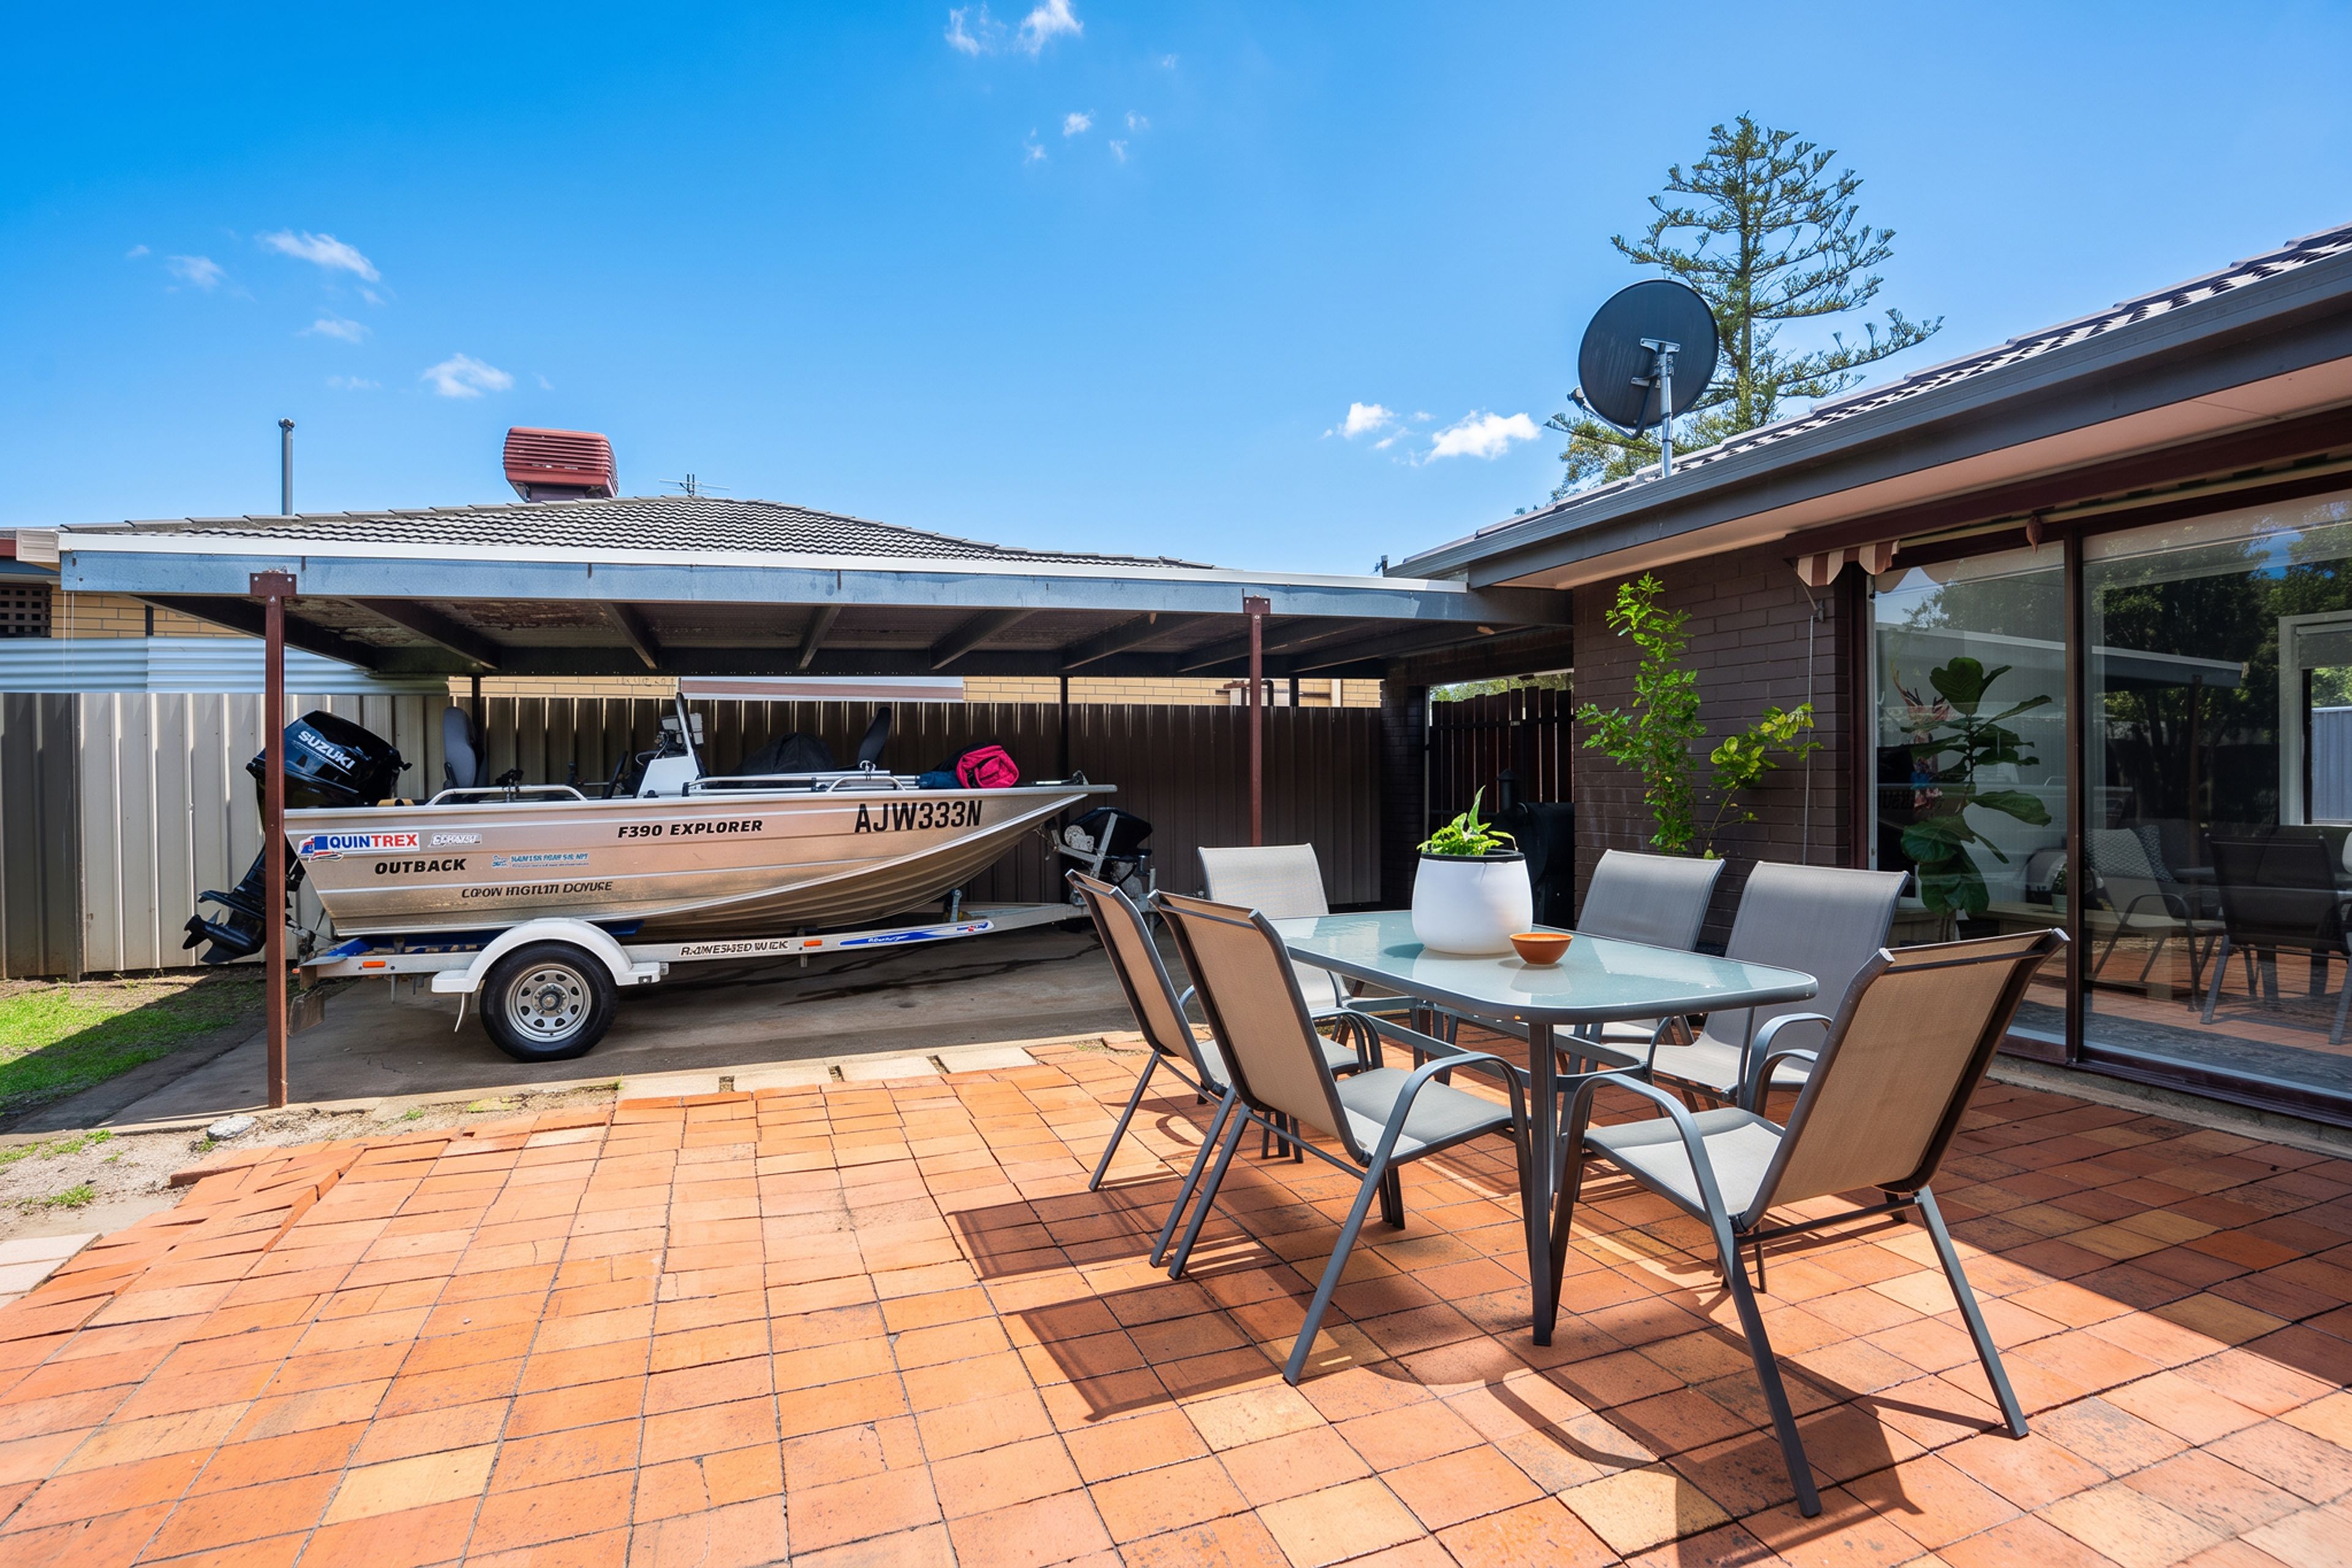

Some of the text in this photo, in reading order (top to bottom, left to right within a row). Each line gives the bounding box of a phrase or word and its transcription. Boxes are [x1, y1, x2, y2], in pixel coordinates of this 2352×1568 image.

[298, 731, 355, 769] SUZUKI
[854, 800, 982, 833] AJW333N
[617, 820, 763, 838] F390 EXPLORER
[330, 834, 418, 849] QUINTREX
[375, 859, 467, 875] OUTBACK
